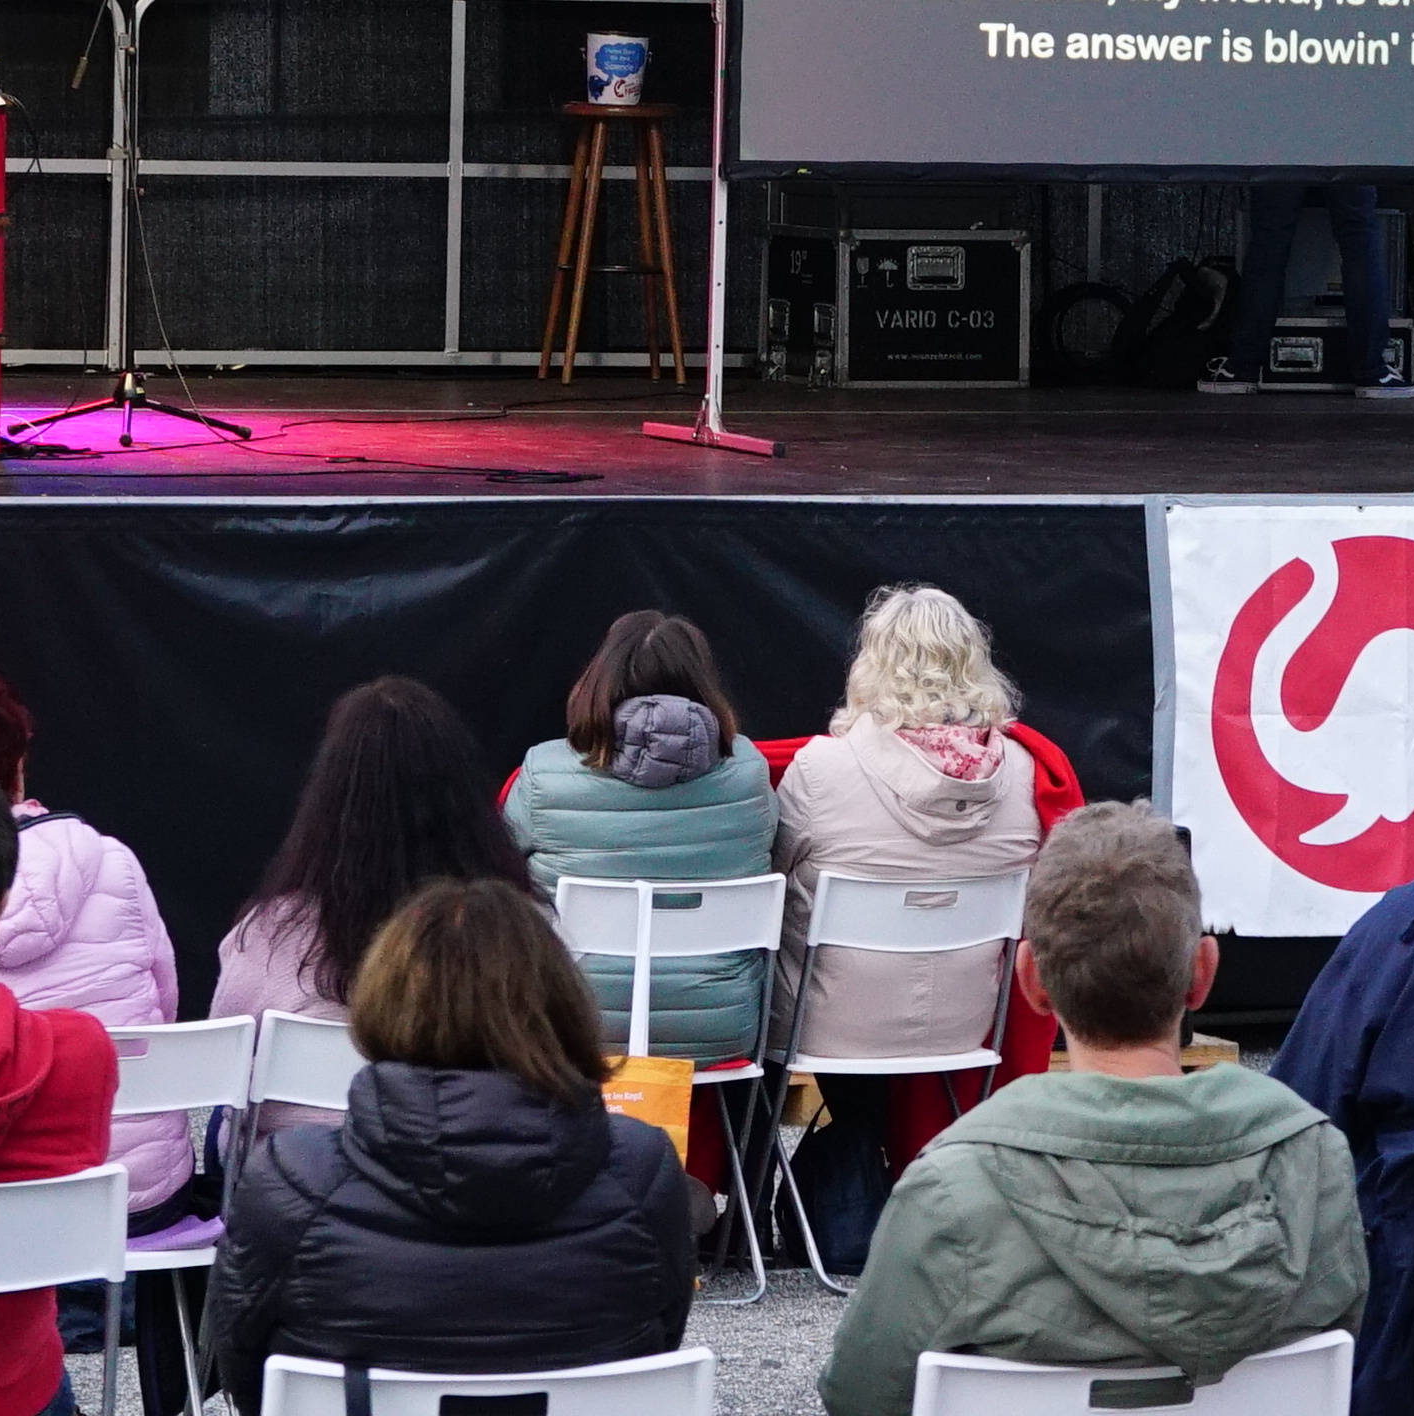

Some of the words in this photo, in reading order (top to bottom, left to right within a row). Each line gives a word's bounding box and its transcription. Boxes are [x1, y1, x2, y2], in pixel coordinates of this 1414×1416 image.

[978, 22, 1055, 59] The
[1065, 32, 1212, 62] answer
[1221, 27, 1253, 63] is
[1264, 28, 1400, 66] blowin'
[875, 308, 937, 329] VARIO
[947, 309, 996, 329] C-03
